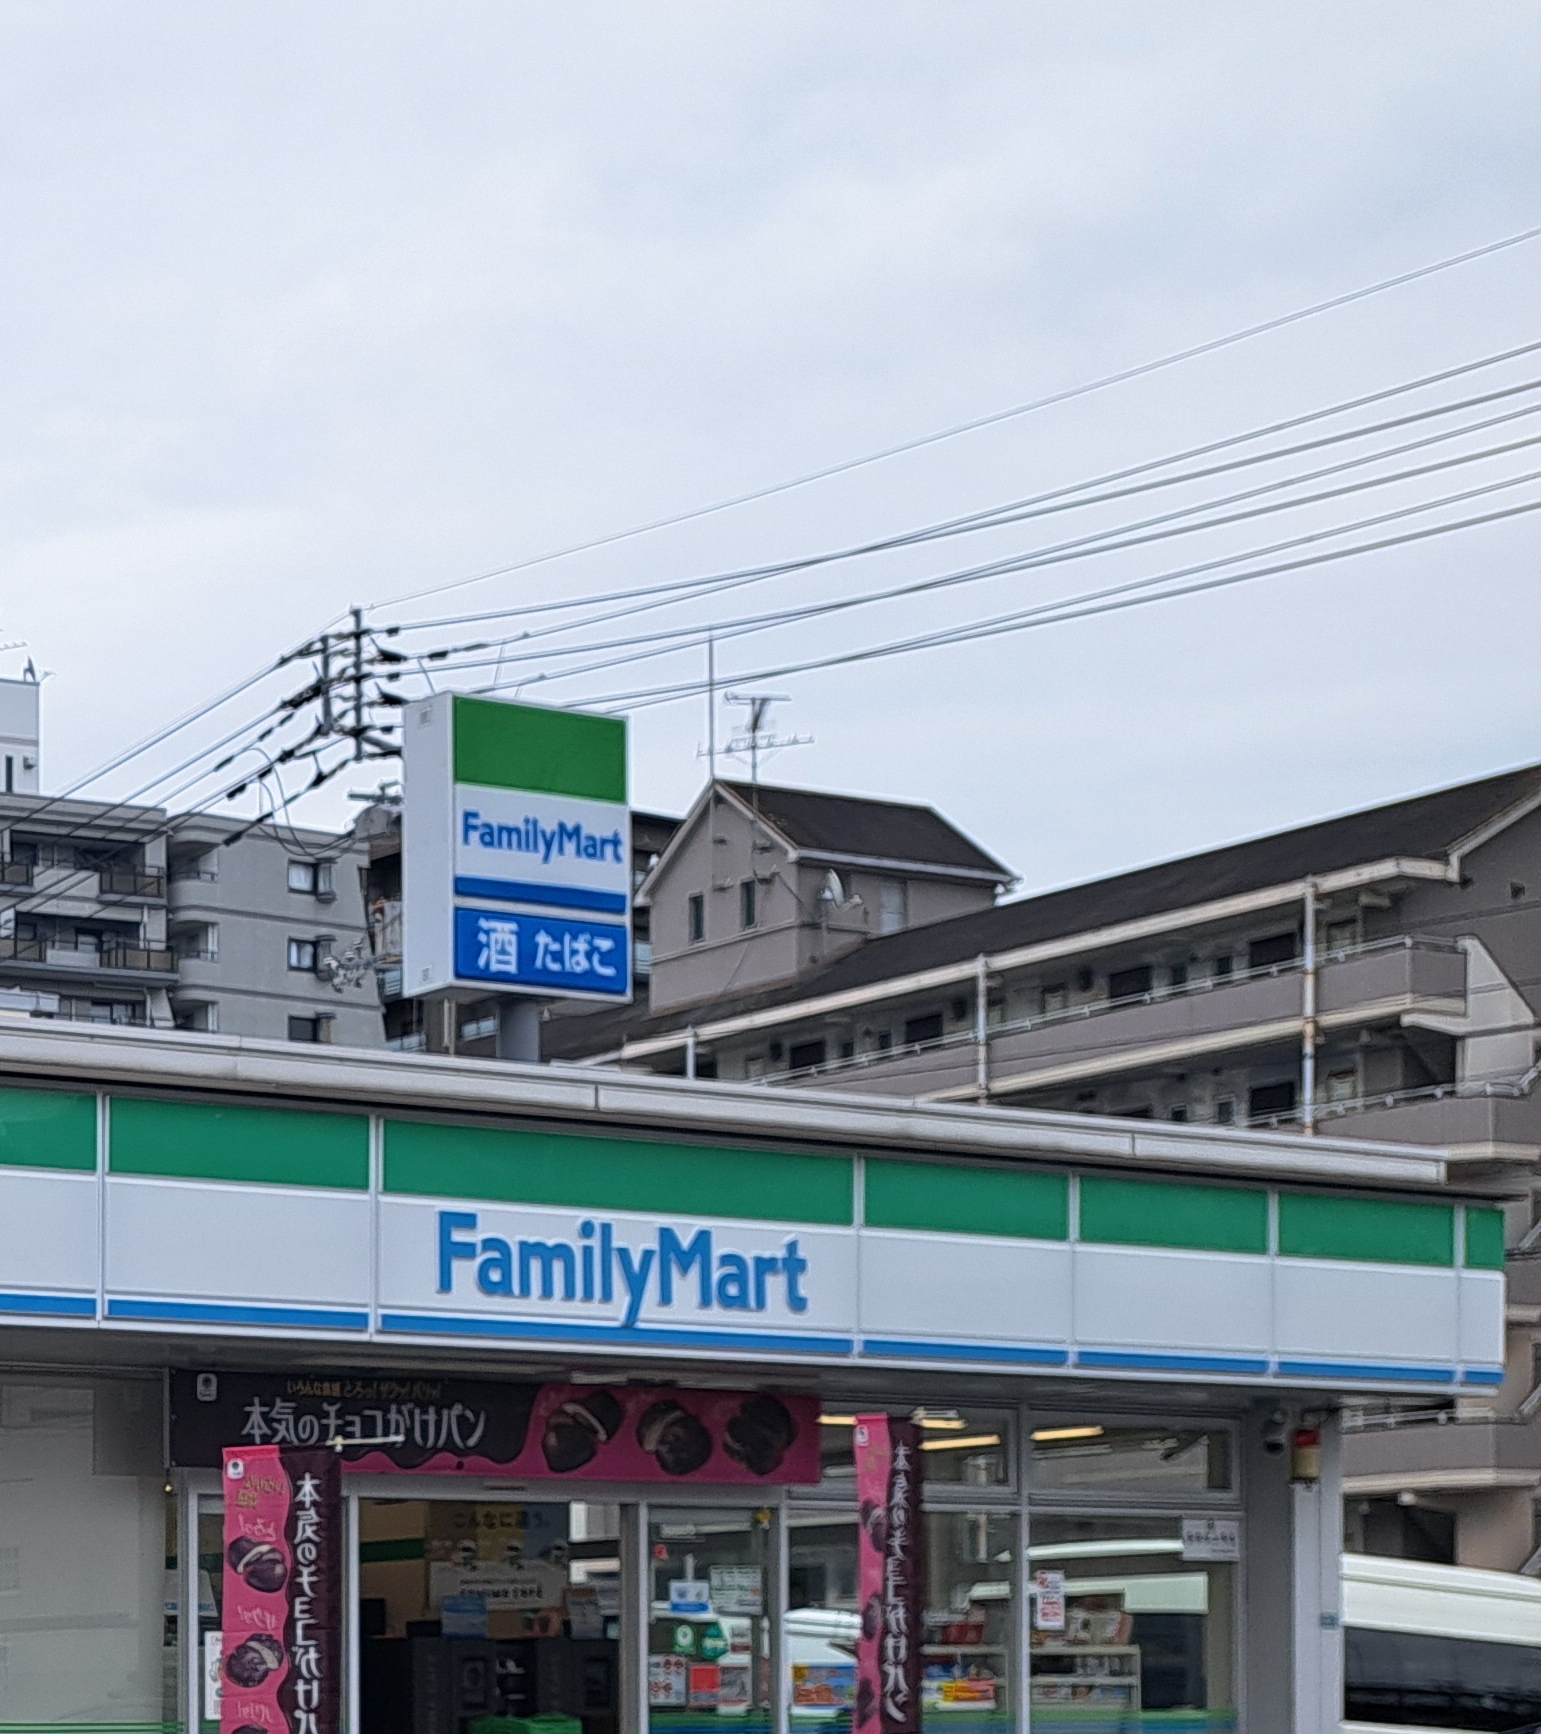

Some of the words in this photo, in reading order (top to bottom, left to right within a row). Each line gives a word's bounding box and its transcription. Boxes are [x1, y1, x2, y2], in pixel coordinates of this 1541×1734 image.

[463, 811, 624, 865] FamilyMart
[477, 917, 519, 975] 酒
[534, 929, 617, 977] たばこ
[438, 1211, 808, 1328] FamilyMart
[241, 1396, 486, 1450] 本気のチョコがけパン
